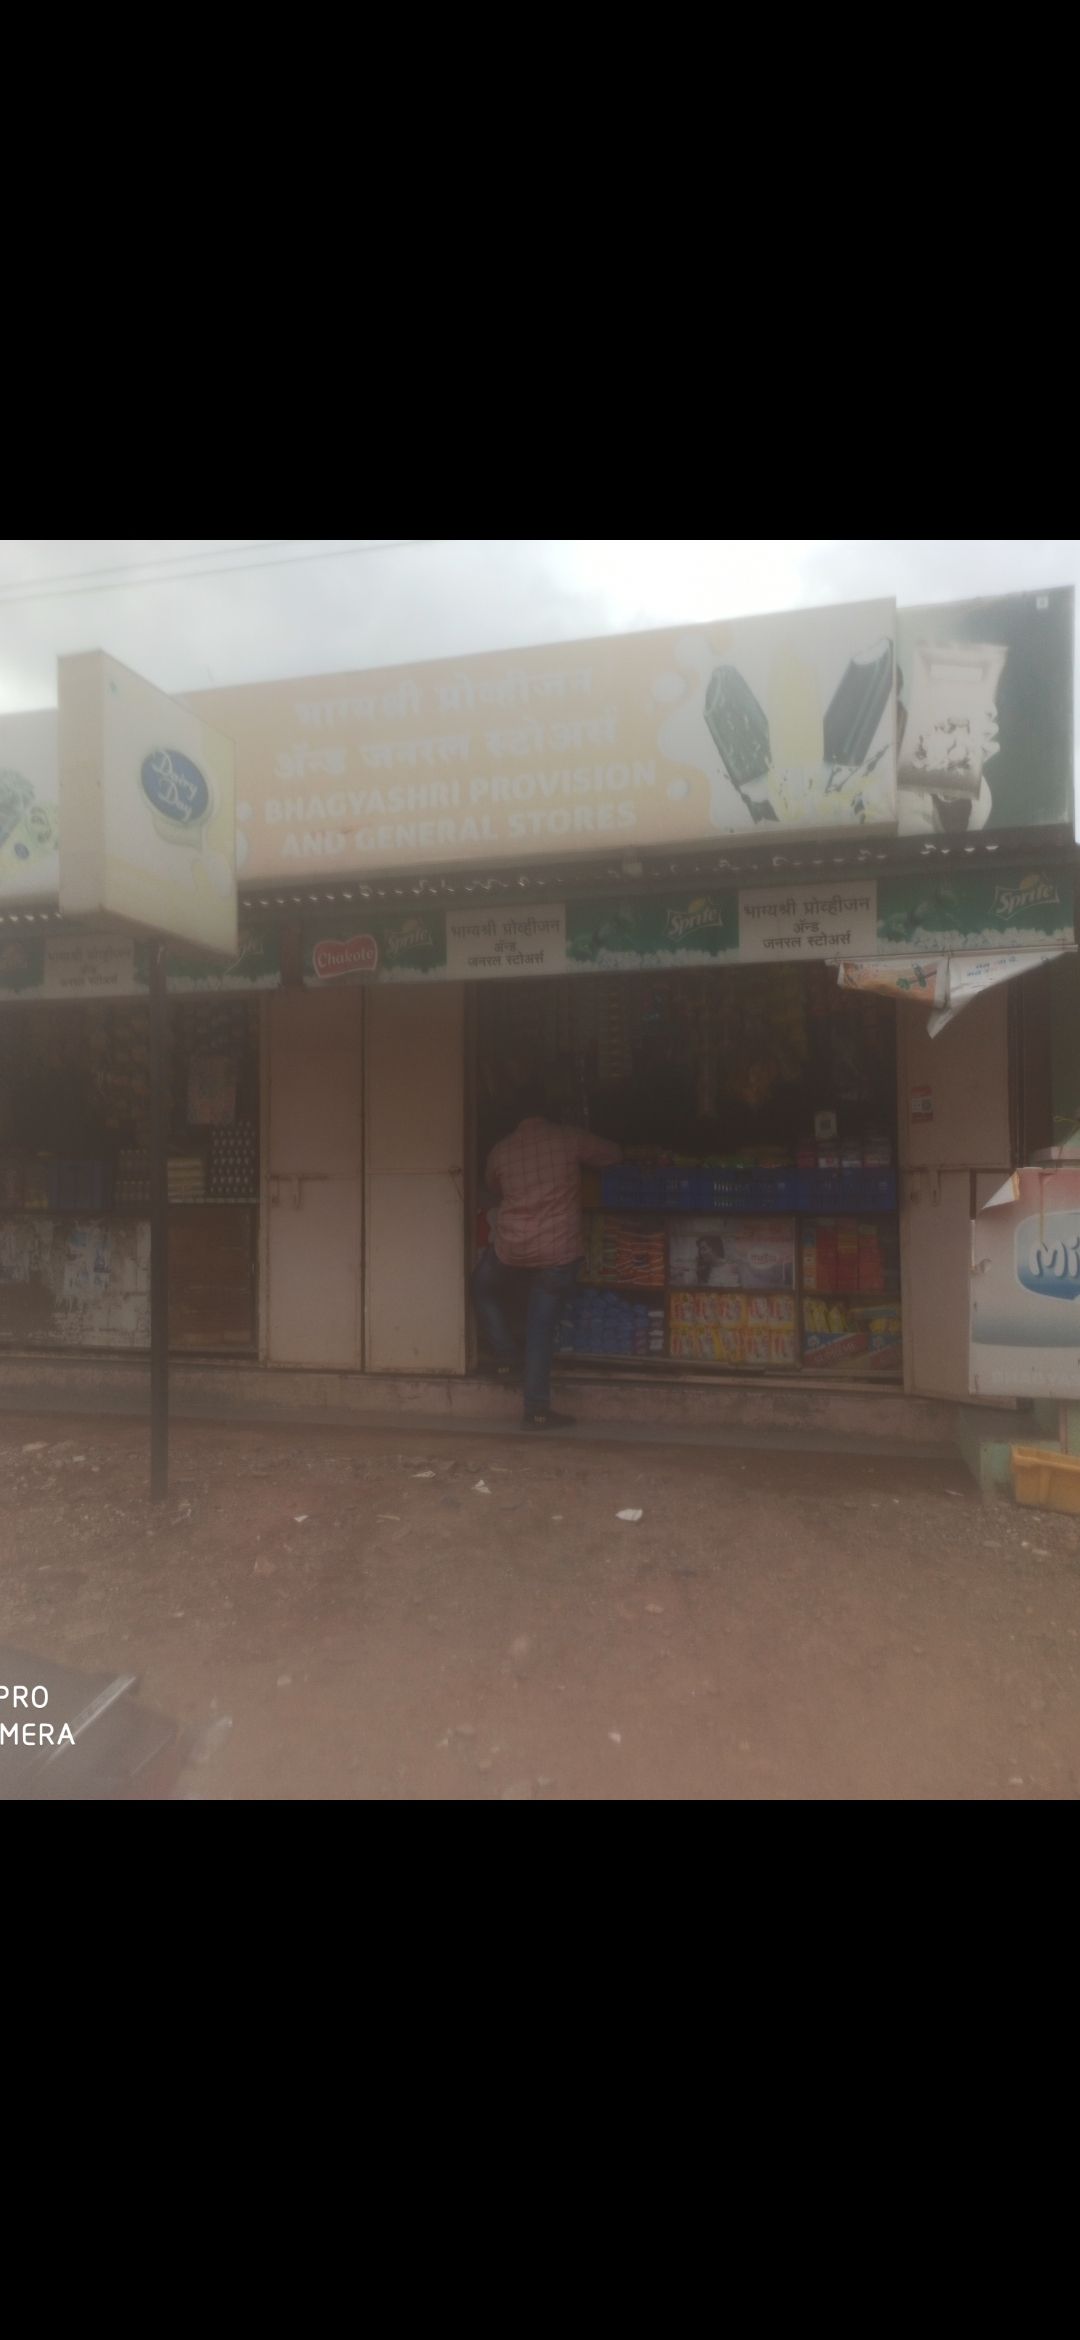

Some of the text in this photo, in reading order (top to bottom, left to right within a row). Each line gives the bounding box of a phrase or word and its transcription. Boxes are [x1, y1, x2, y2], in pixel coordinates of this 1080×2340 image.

[296, 678, 424, 729] भाग्यश्री
[360, 732, 472, 771] जनरल
[158, 781, 192, 822] Day
[264, 759, 657, 825] BHAGYASHRI PROVISION
[280, 801, 638, 859] AND GENERAL STORES
[743, 894, 870, 918] भाग्यश्री प्रोव्हीजन
[997, 882, 1053, 914] Sprite
[450, 919, 497, 939] भाग्यश्री
[667, 903, 719, 936] Sprite
[763, 930, 852, 949] जनरल स्टोअर्स
[317, 946, 374, 968] Chakote
